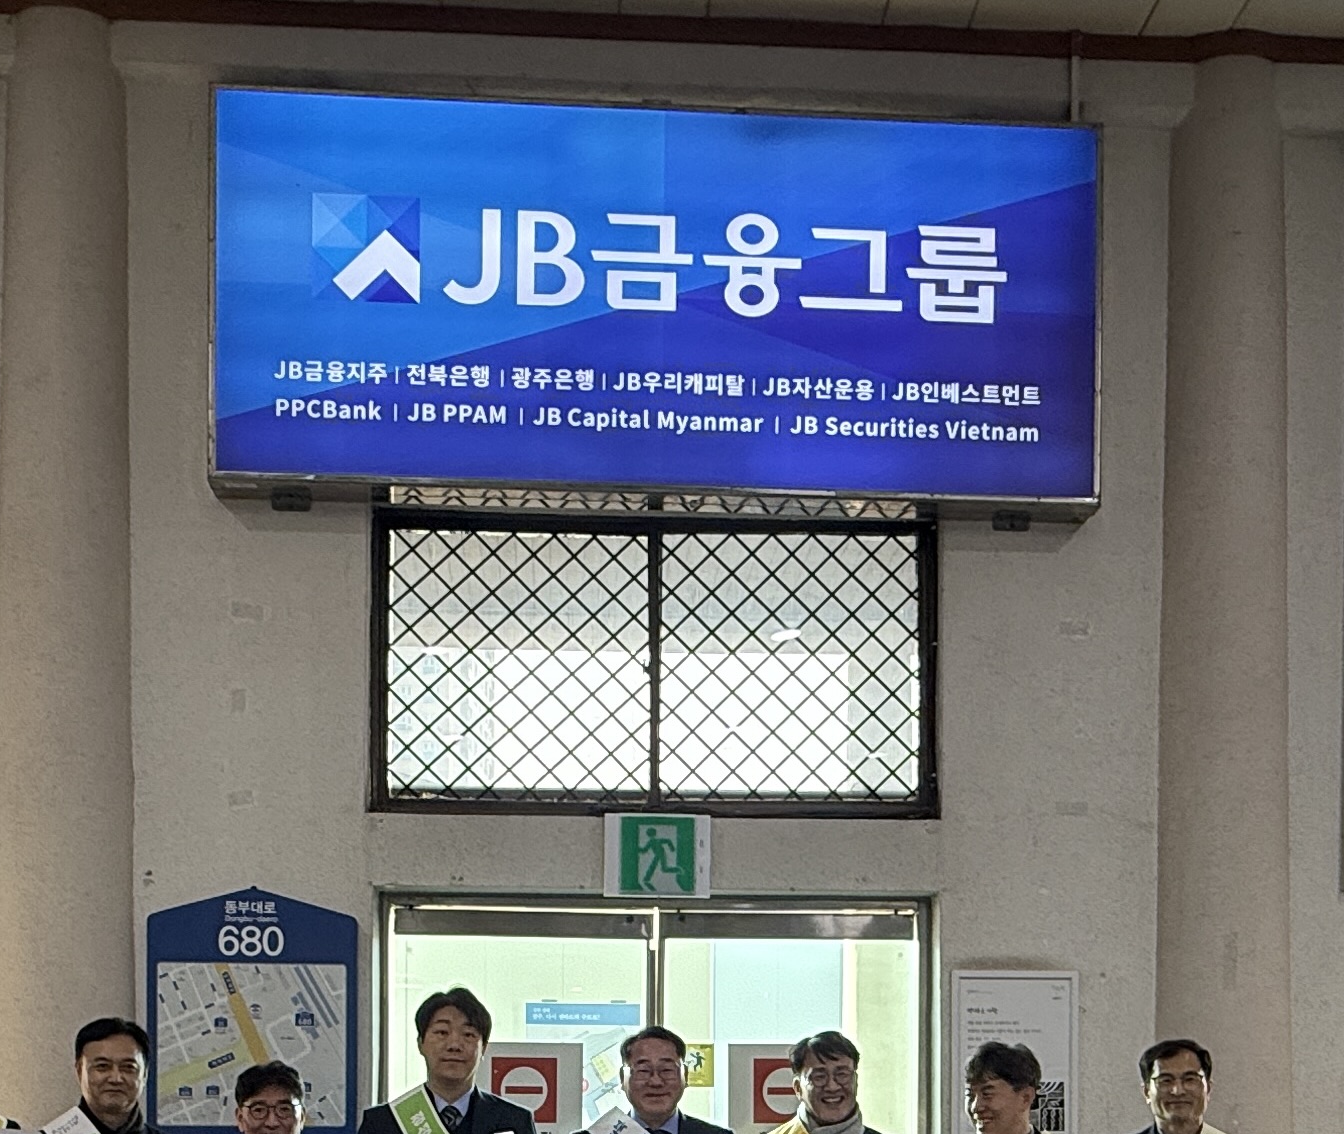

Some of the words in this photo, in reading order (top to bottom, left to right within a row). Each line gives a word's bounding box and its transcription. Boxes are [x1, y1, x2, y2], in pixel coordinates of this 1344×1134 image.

[442, 208, 1009, 325] JB금융그룹
[273, 359, 389, 385] JB금융지주
[406, 362, 491, 389] 전북은행
[510, 365, 596, 392] 광주은행
[613, 369, 745, 398] JB우리캐피탈
[762, 374, 875, 402] JB자산운용
[892, 378, 1041, 407] JB인베스트먼트
[274, 398, 382, 422] PPCBank
[406, 403, 437, 424] JB
[442, 404, 507, 425] PPAM
[533, 407, 562, 427] JB
[567, 408, 650, 433] Capital
[657, 411, 764, 437] Myanmar
[790, 415, 819, 435] JB
[825, 416, 940, 440] Securities
[945, 419, 1039, 443] Vietnam
[224, 901, 277, 915] 동부대로
[218, 925, 285, 957] 680
